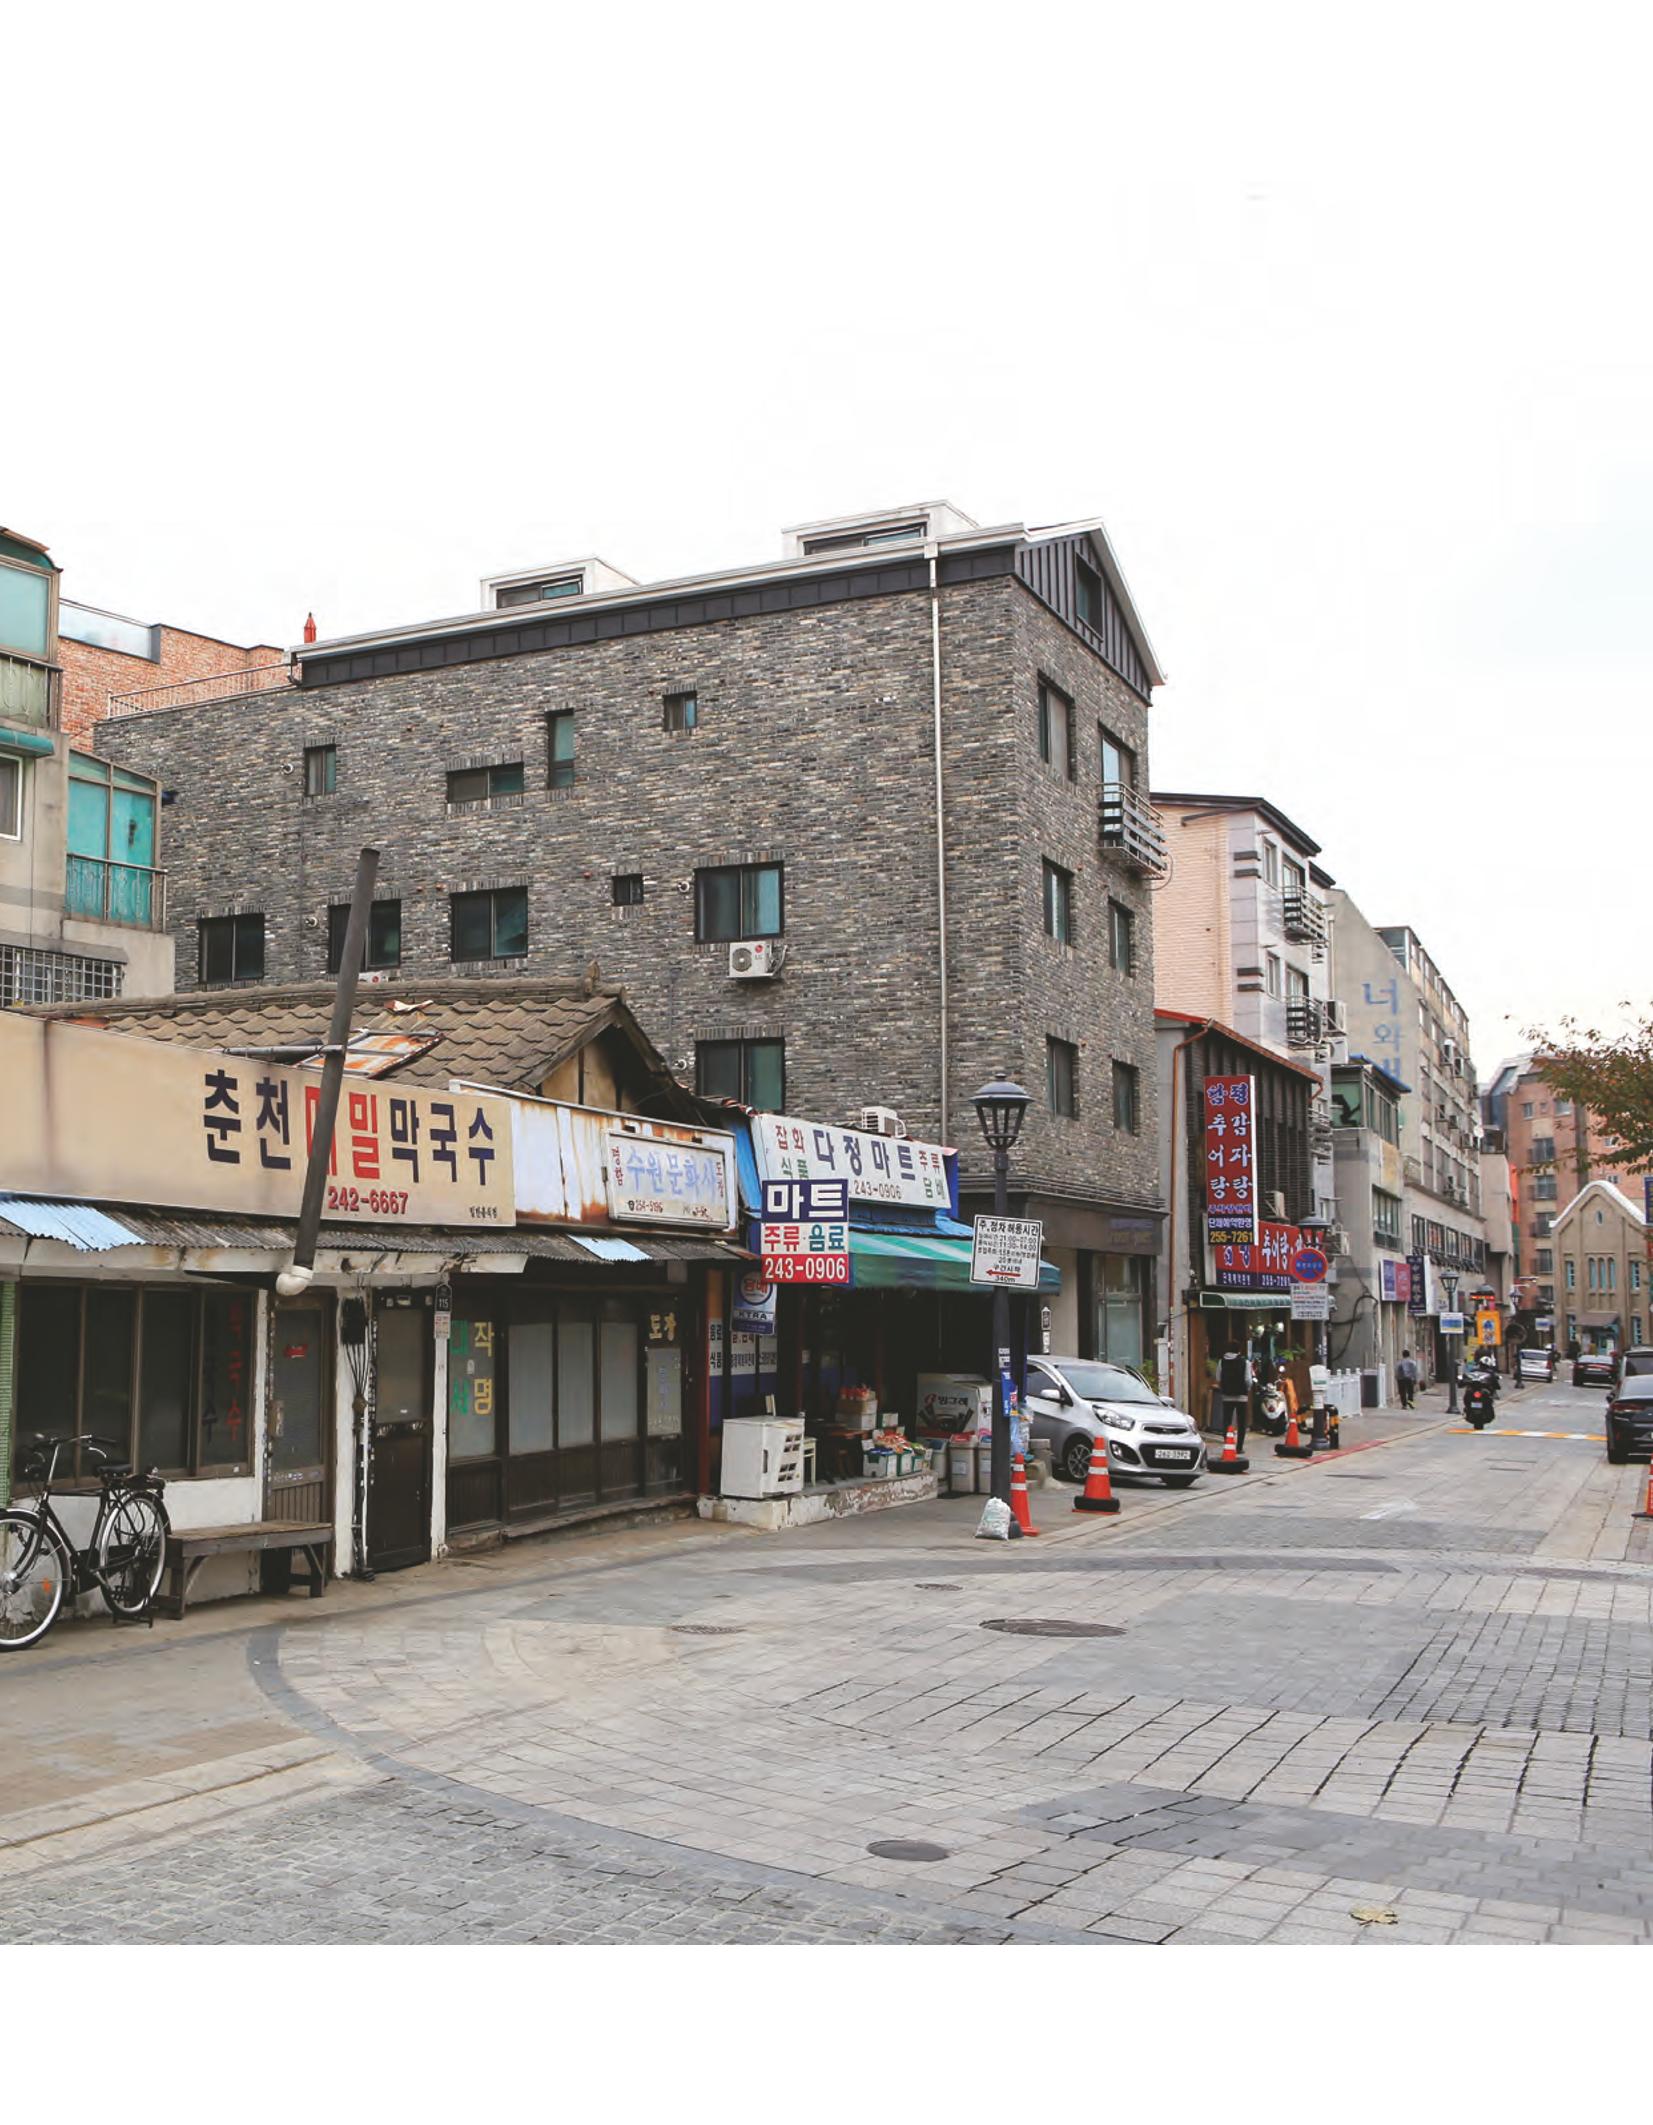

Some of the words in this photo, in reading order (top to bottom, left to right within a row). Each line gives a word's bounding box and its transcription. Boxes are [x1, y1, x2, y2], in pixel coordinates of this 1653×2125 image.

[775, 1125, 805, 1153] 잡화
[813, 1129, 916, 1181] 다정마트
[918, 1150, 940, 1175] 주류
[1208, 1114, 1230, 1199] 추어탕
[1230, 1111, 1252, 1199] 감자탕
[626, 1146, 717, 1202] 수원문화사
[922, 1177, 946, 1200] 담배
[328, 1186, 409, 1215] 242-6667
[767, 1183, 845, 1220] 마트
[854, 1179, 902, 1200] 243-0906
[1210, 1231, 1253, 1244] 255-7261
[765, 1257, 846, 1281] 243-0906
[649, 1312, 677, 1341] 도장
[474, 1321, 494, 1415] 작명
[938, 1396, 968, 1406] 빙그레
